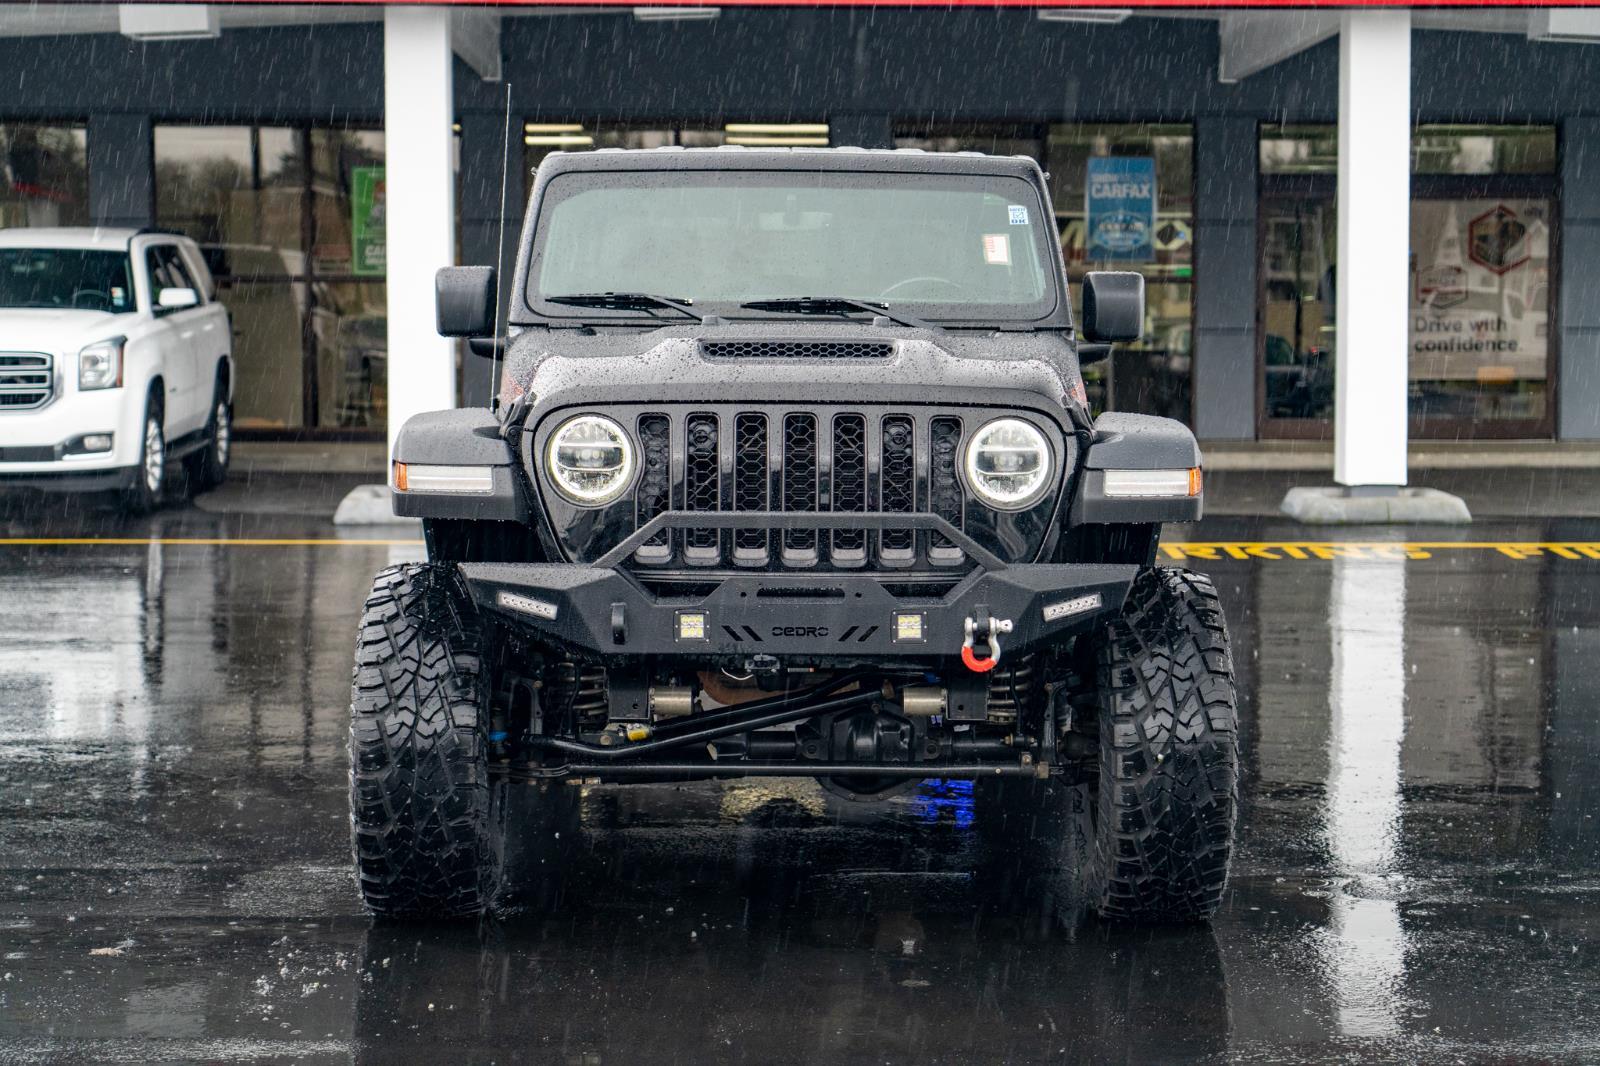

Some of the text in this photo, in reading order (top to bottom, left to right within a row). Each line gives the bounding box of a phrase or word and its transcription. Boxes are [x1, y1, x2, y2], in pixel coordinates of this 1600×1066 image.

[1091, 183, 1151, 199] CARFAX
[1415, 316, 1507, 332] Drive with
